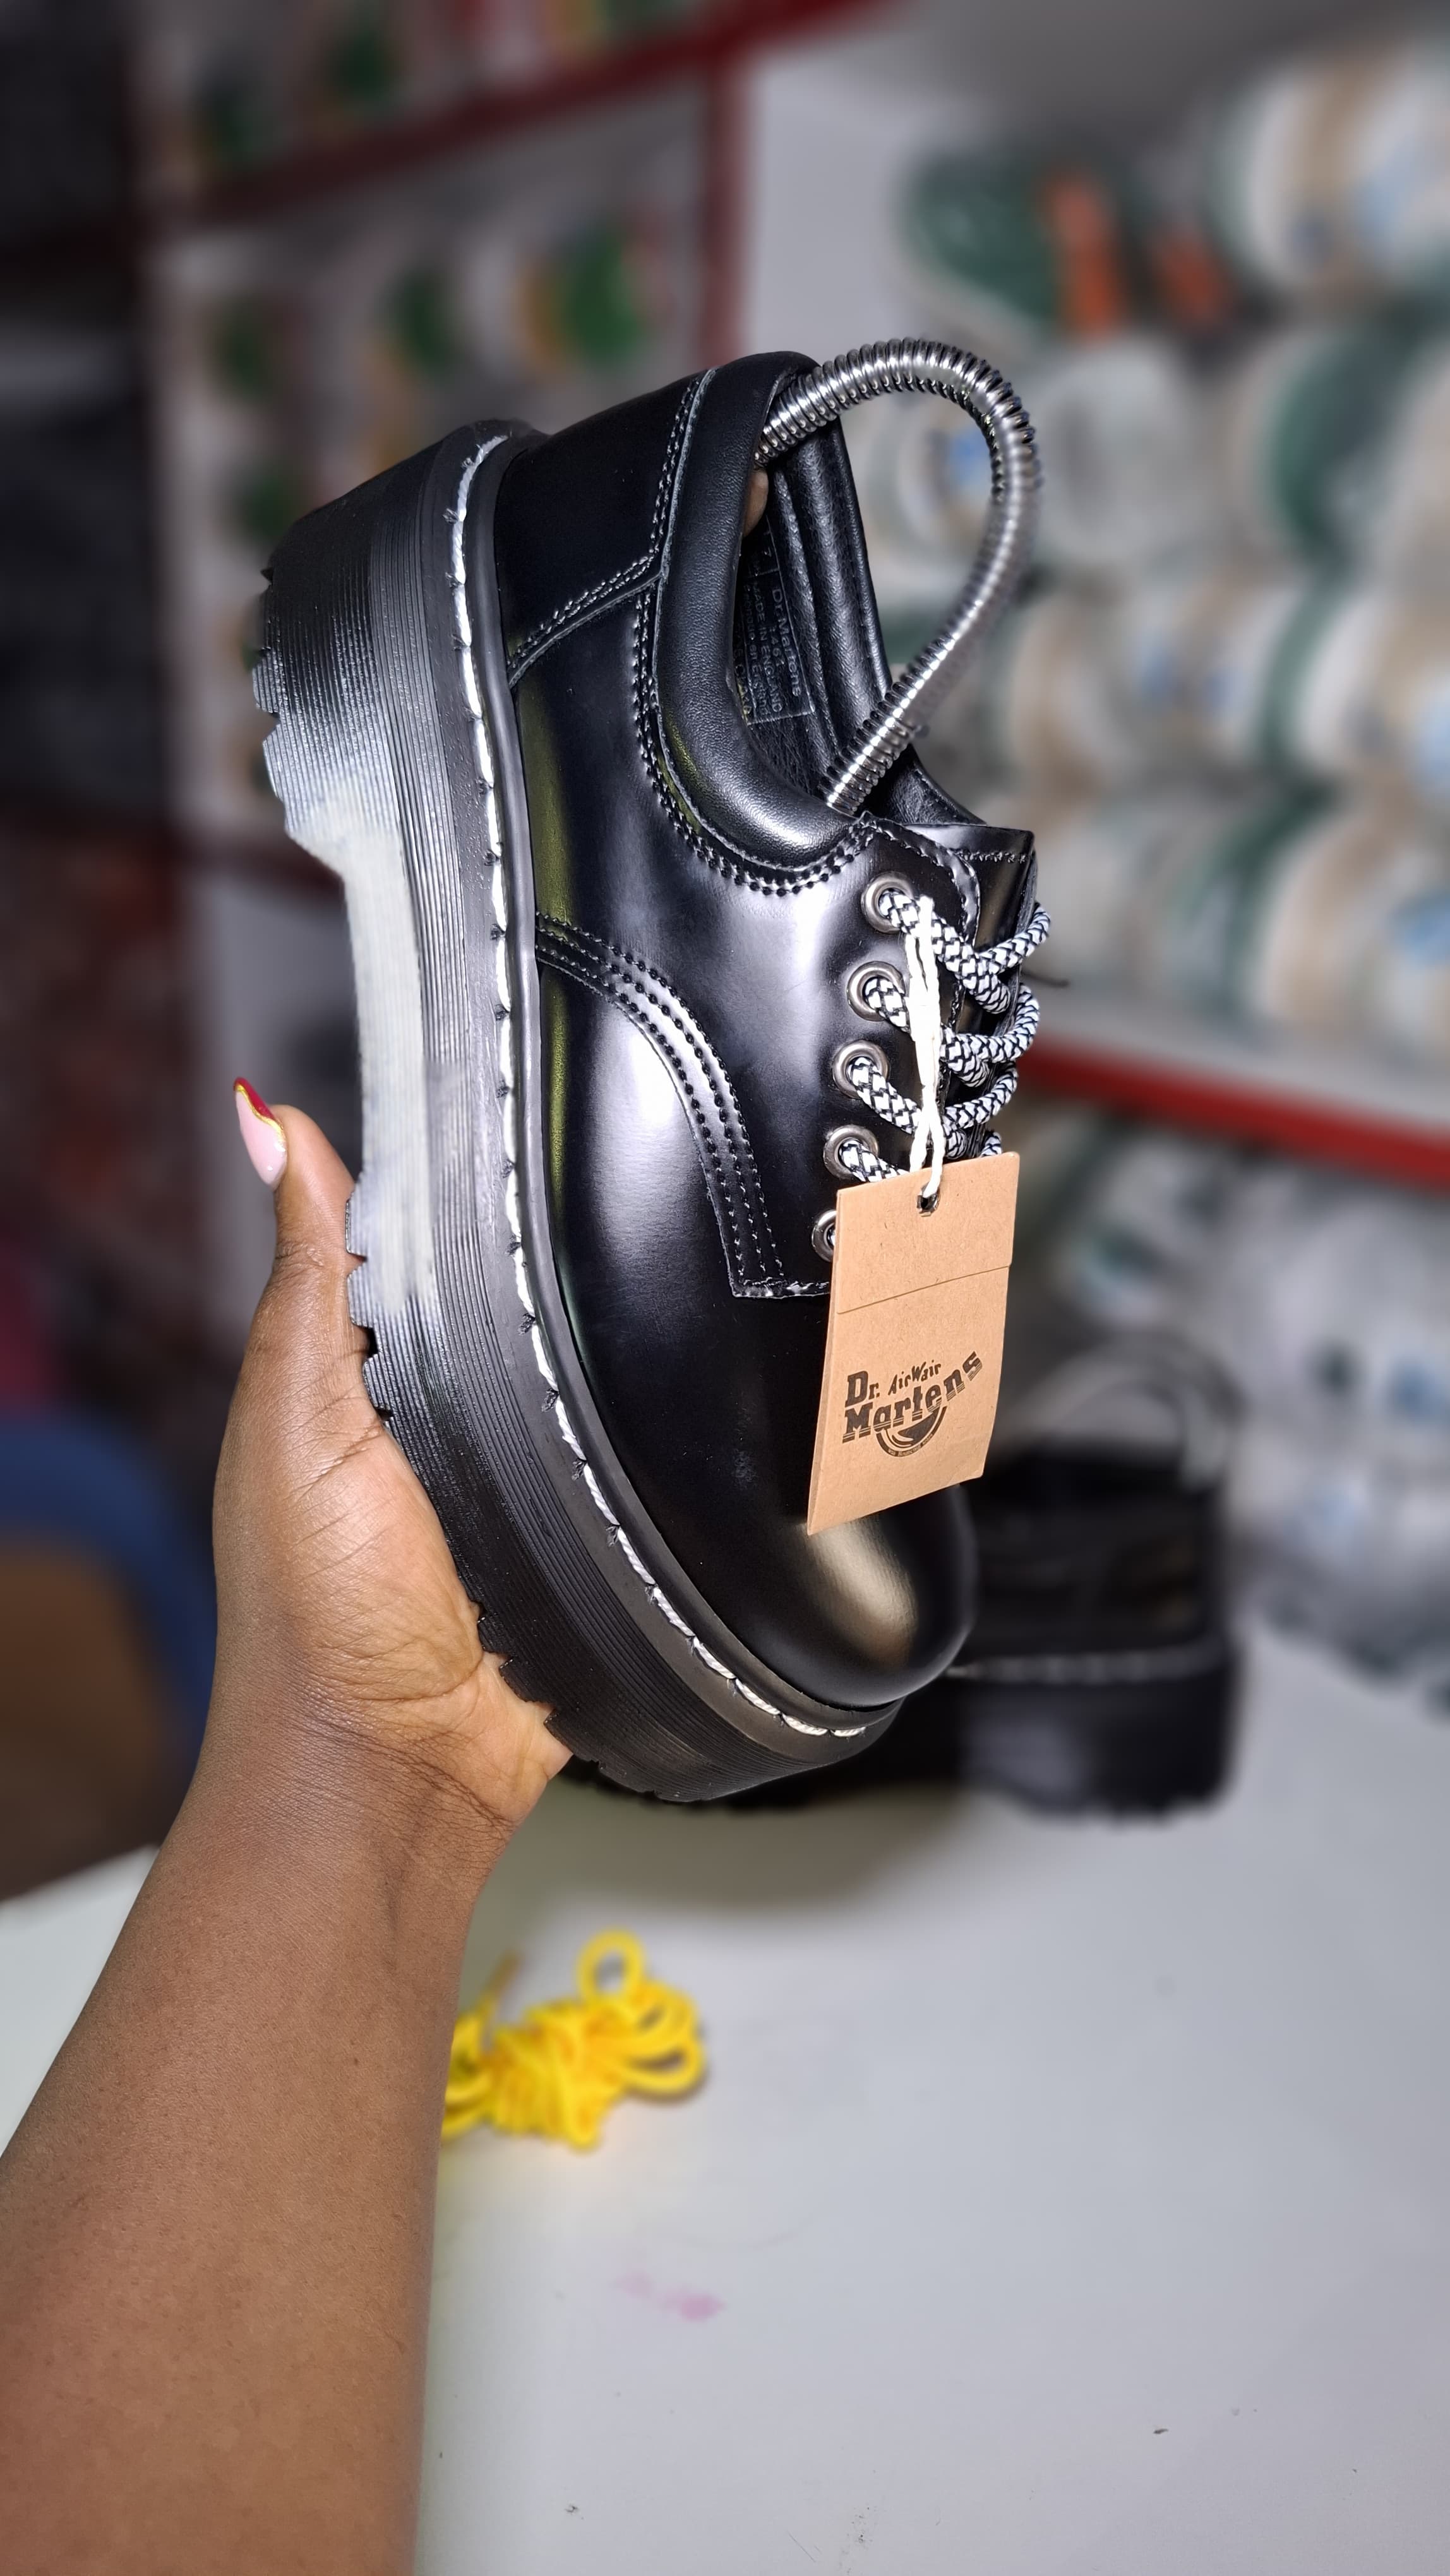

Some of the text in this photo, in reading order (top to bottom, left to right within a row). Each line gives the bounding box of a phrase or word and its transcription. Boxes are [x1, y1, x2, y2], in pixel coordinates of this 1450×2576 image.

[752, 580, 765, 623] MADE
[758, 626, 768, 641] IN
[761, 645, 782, 712] ENGLAND
[842, 1351, 983, 1444] Martens
[845, 1359, 941, 1407] Dr. AirWair
